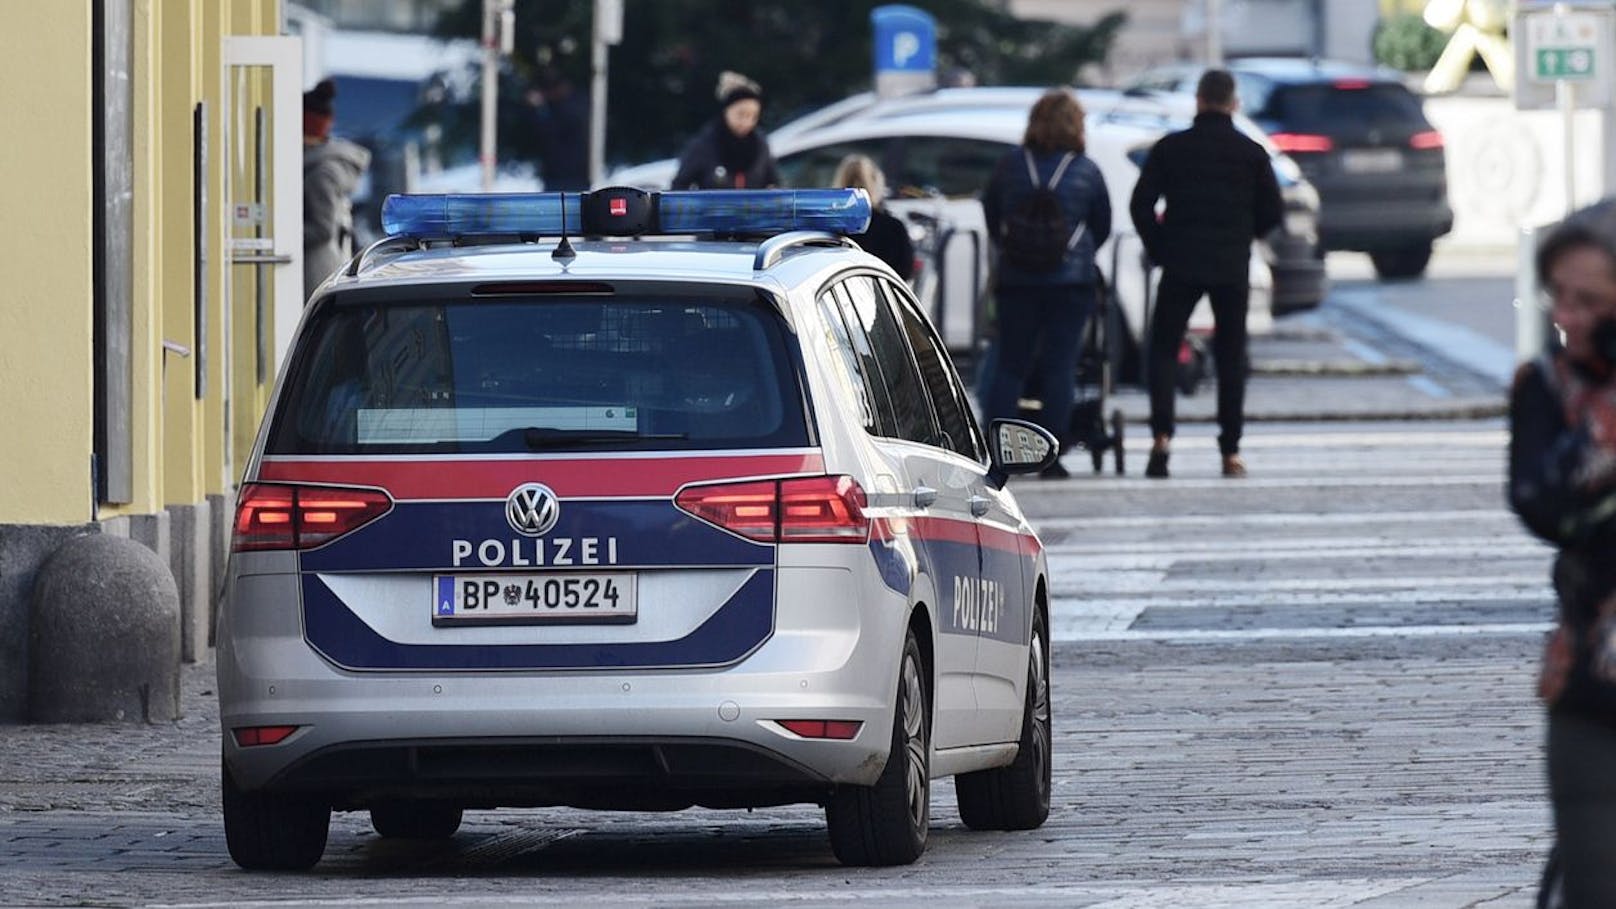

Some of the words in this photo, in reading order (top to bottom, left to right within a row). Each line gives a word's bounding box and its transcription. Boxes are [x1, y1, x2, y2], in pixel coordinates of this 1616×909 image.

[893, 31, 919, 67] P
[510, 487, 554, 533] VW
[452, 537, 617, 567] POLIZEI
[442, 600, 451, 611] A
[463, 580, 500, 610] BP
[524, 578, 620, 609] 40524
[952, 575, 999, 634] POLIZEI
